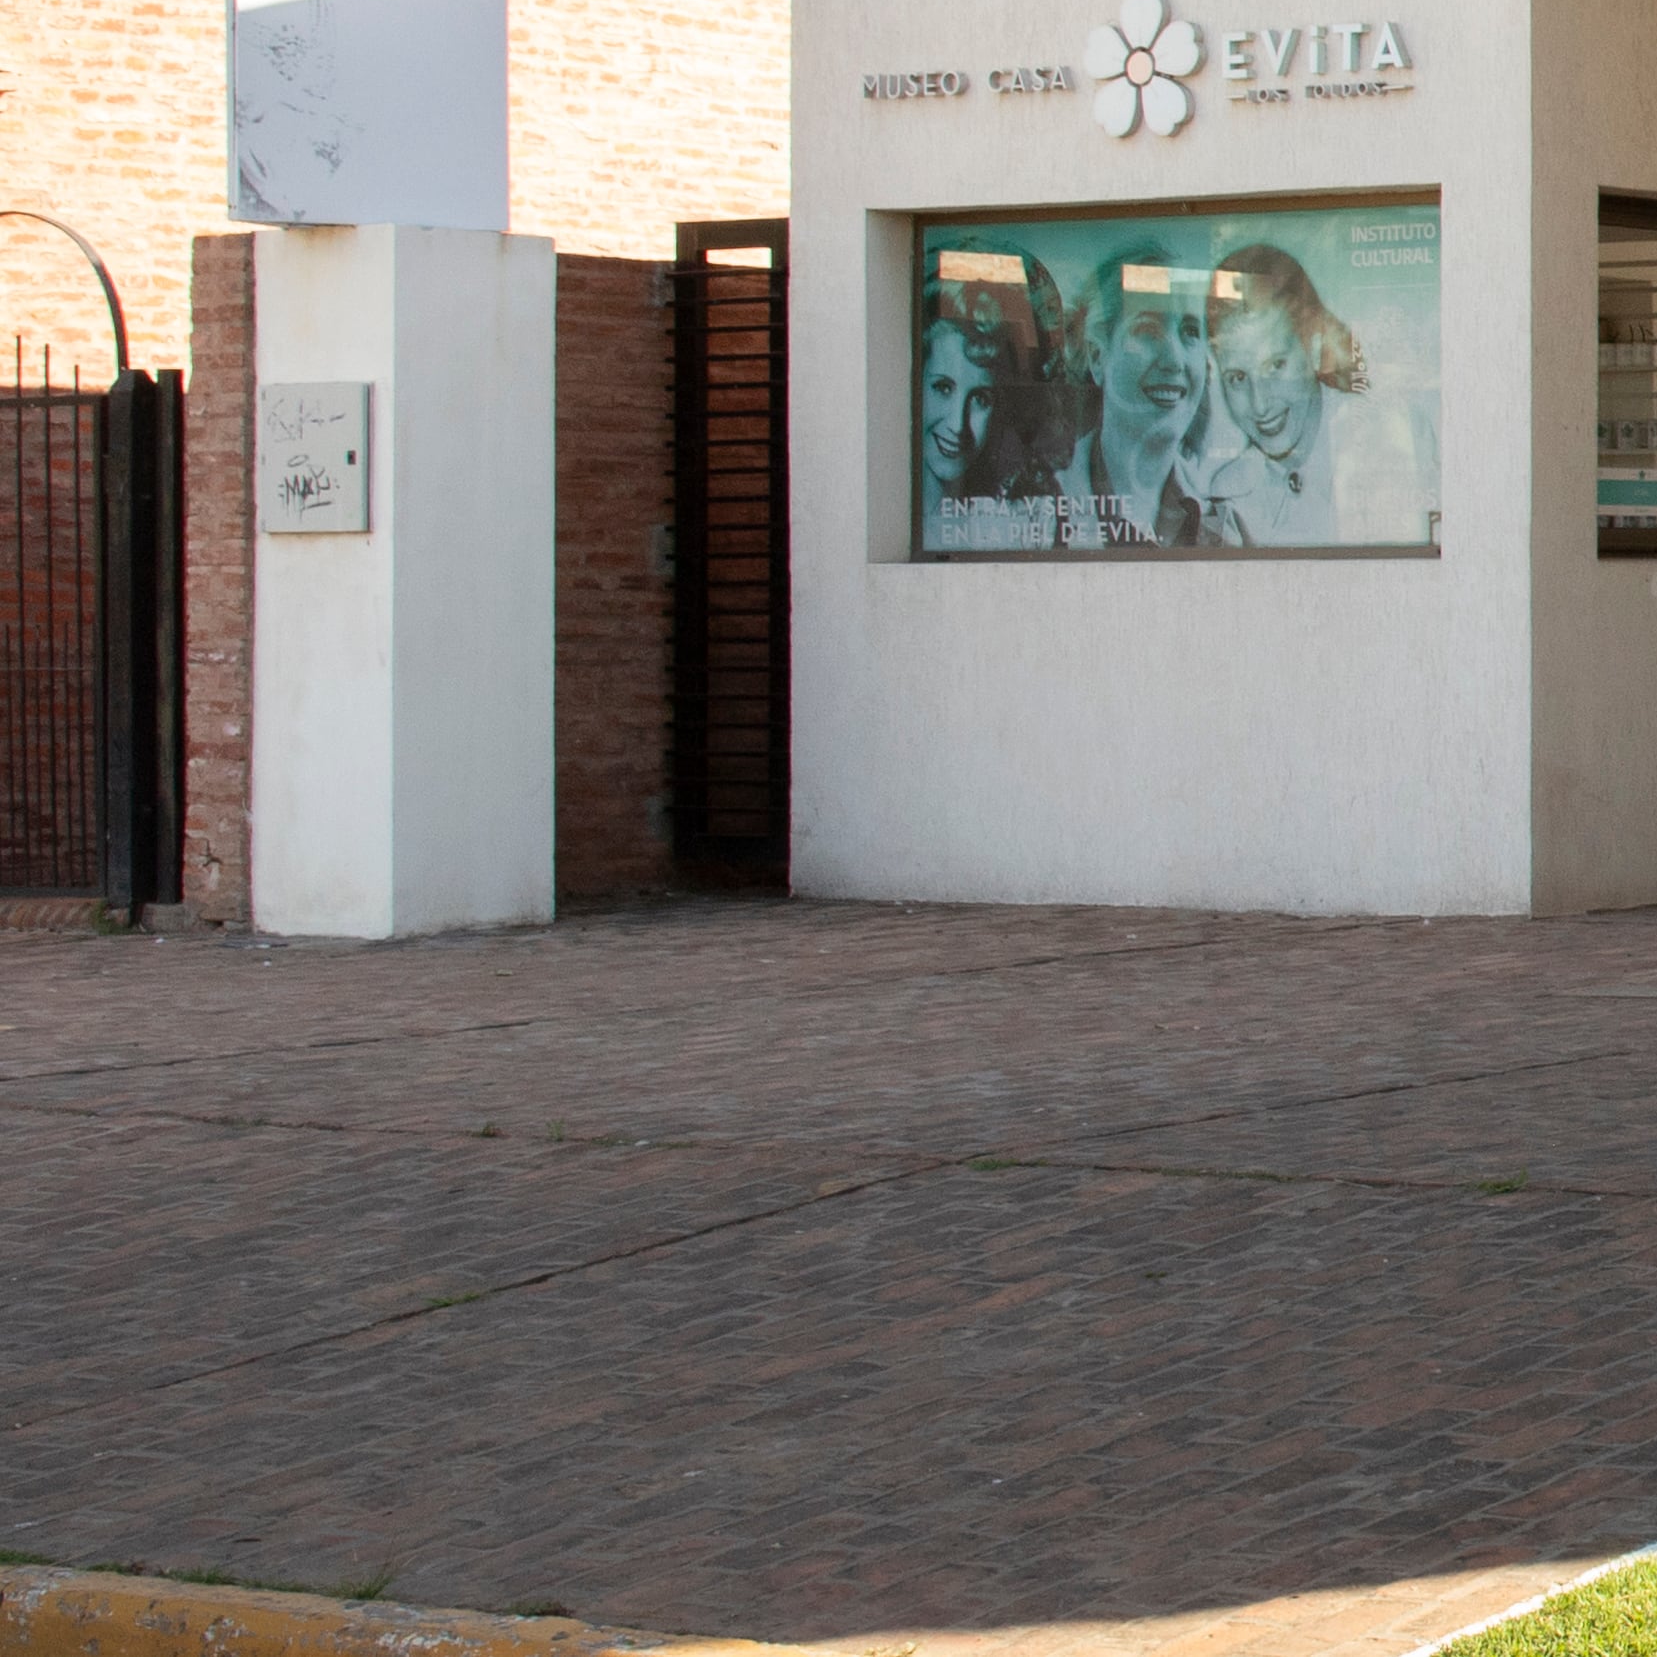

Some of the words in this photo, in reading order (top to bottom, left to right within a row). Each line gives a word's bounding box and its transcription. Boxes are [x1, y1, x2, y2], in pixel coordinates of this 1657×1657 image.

[863, 71, 964, 99] MUSEO
[988, 65, 1070, 94] CASA
[1351, 222, 1436, 243] INSTITUTO
[1351, 246, 1434, 267] CULTURAL
[1023, 495, 1038, 517] Y
[1043, 494, 1133, 517] SENTITE
[941, 523, 968, 545] EN
[1010, 521, 1054, 544] PIEL
[1061, 521, 1090, 543] DE
[1098, 520, 1164, 542] EVITA.
